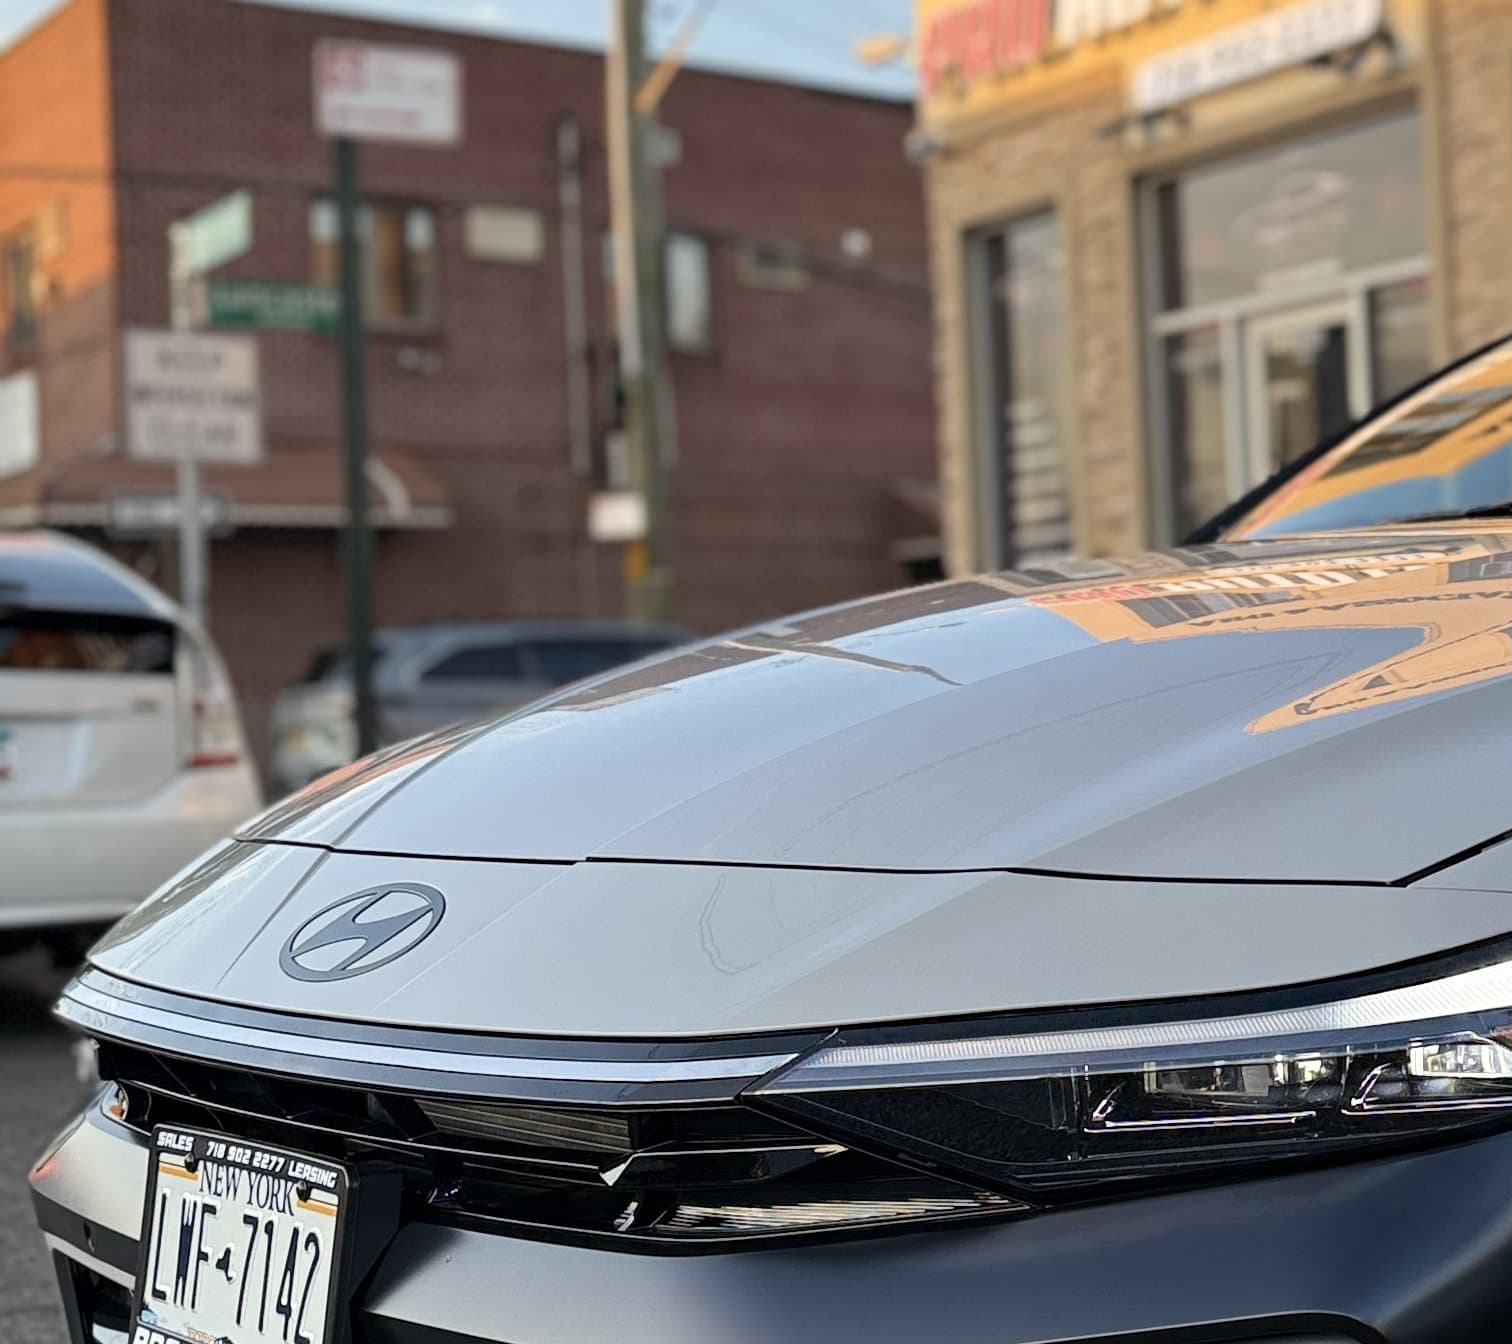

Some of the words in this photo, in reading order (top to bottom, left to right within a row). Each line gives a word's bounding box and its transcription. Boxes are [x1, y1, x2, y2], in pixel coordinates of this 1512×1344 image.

[157, 1131, 195, 1153] SALES
[206, 1141, 225, 1159] 718
[252, 1150, 285, 1171] 2277
[288, 1160, 338, 1188] LEASING
[200, 1161, 241, 1201] NEW
[246, 1170, 295, 1216] YORK
